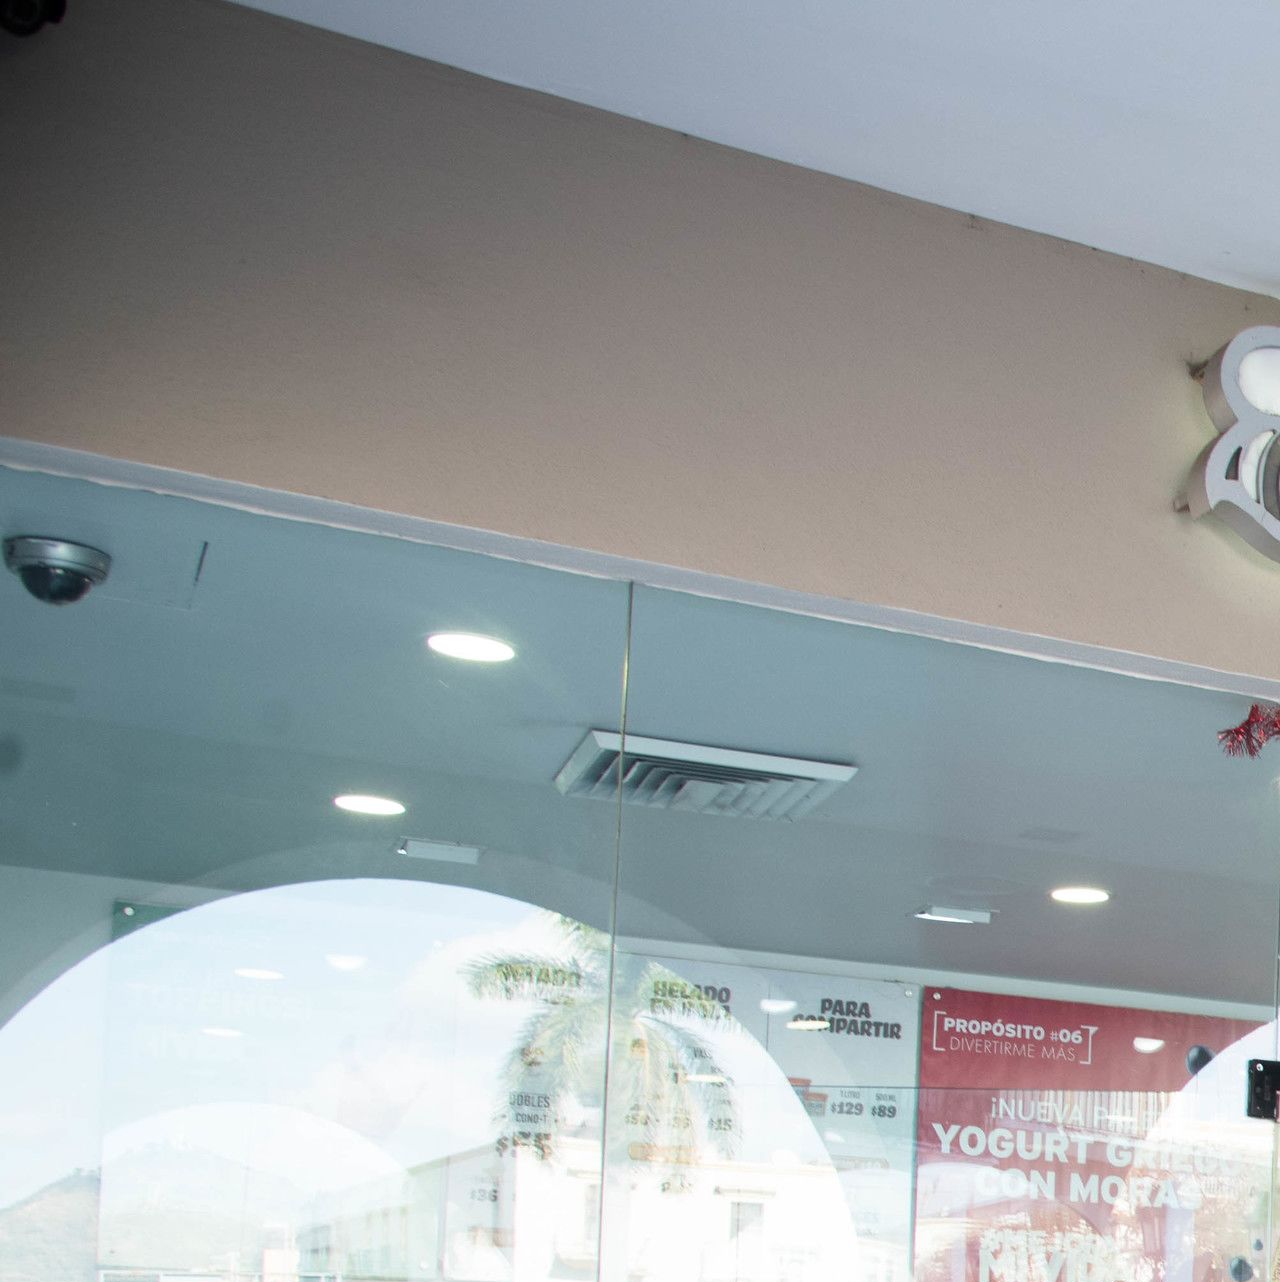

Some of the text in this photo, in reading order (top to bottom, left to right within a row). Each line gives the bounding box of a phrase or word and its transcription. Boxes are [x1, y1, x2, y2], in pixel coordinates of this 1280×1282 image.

[820, 998, 872, 1019] PARA
[943, 1016, 1084, 1045] PROPÓSITO #06
[949, 1036, 1035, 1059] DIVERTIRME
[932, 1122, 1095, 1165] YOGURT
[976, 1168, 1057, 1201] CON
